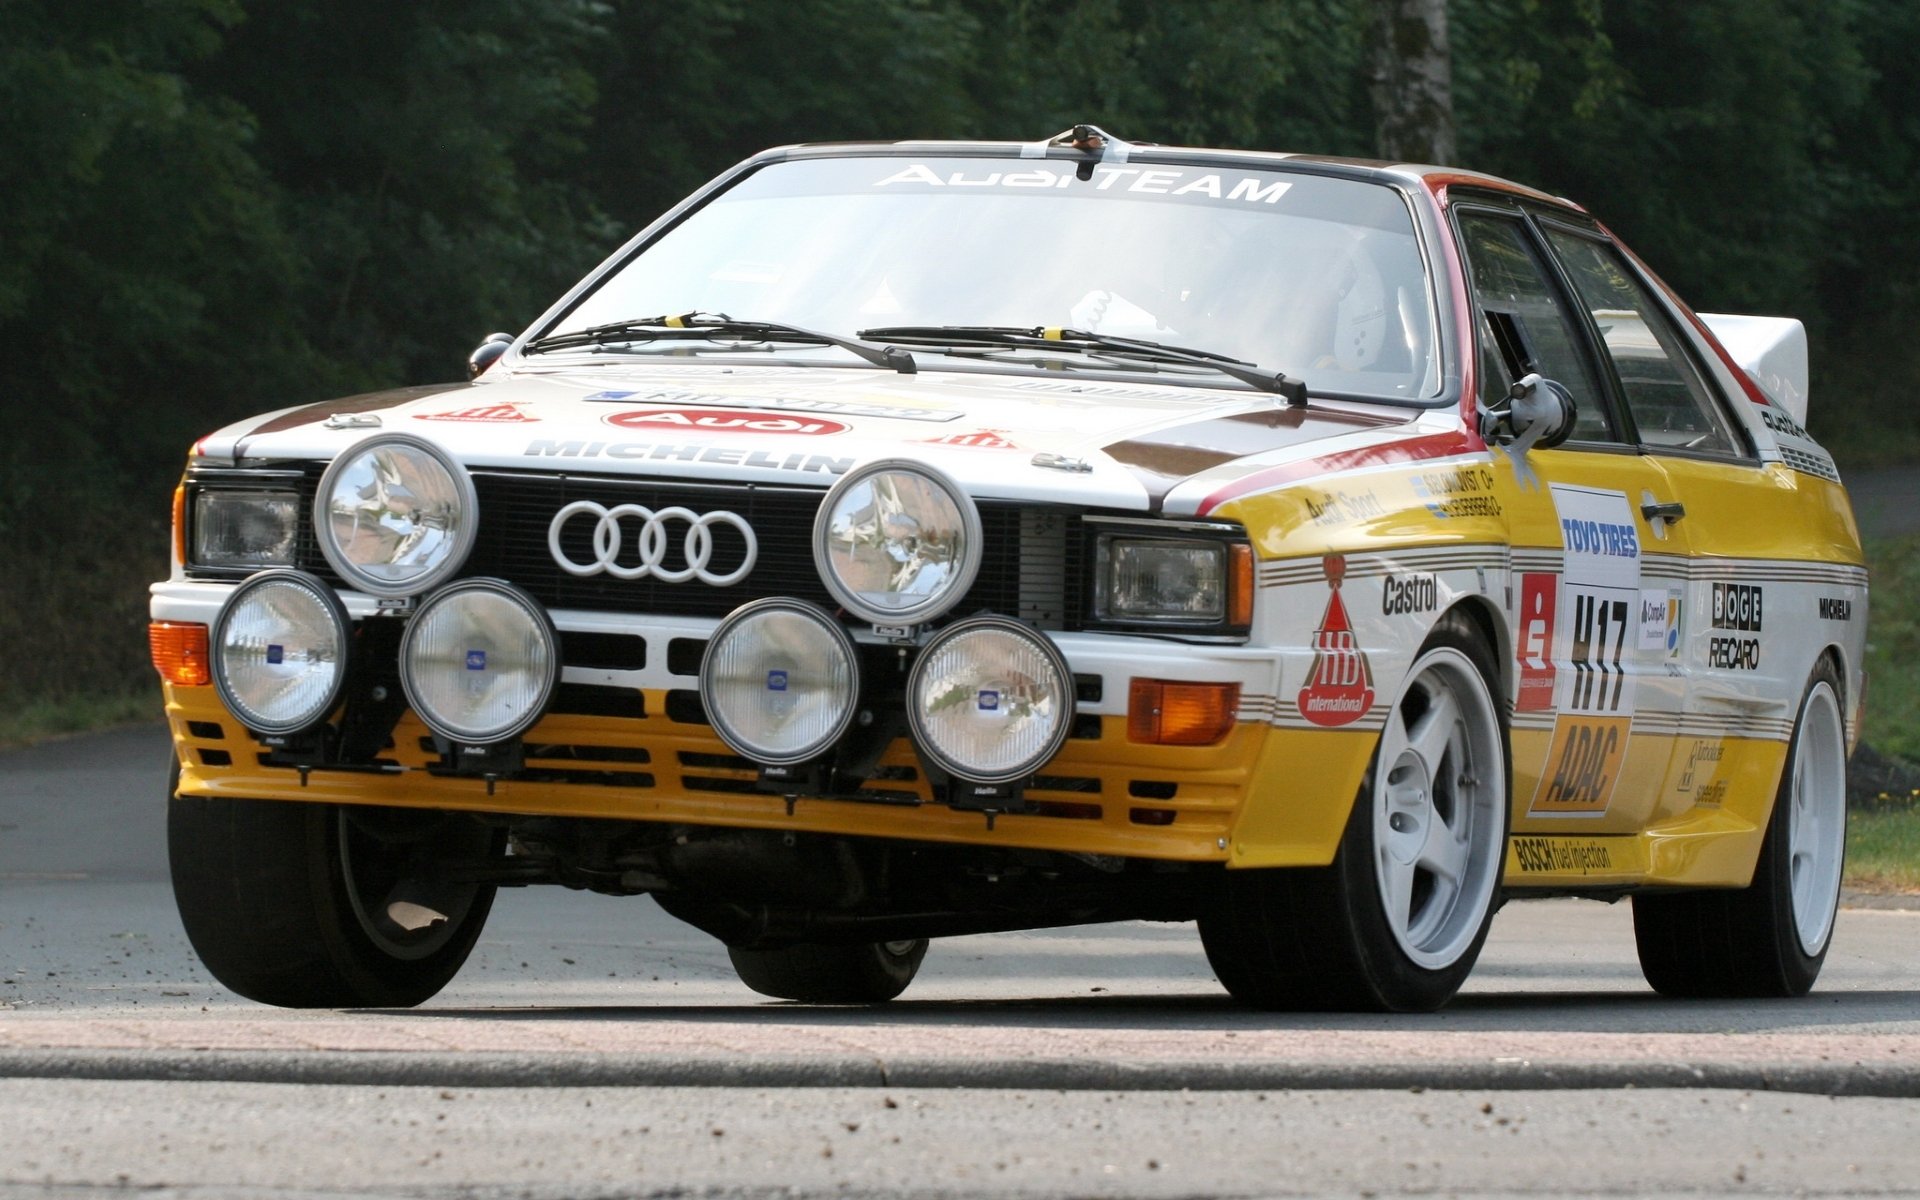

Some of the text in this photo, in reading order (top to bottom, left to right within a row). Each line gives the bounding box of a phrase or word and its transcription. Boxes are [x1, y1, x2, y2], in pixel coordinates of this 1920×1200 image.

[621, 412, 825, 433] Audi
[523, 440, 856, 475] MICHELIN
[1562, 519, 1638, 558] TOYO TIRES
[1382, 573, 1437, 615] Castrol
[1713, 588, 1761, 624] BOGE
[1647, 602, 1666, 624] CompAir
[1312, 630, 1361, 686] HB
[1572, 594, 1628, 711] H17
[1708, 637, 1760, 670] RECARO
[1306, 694, 1365, 712] international
[1546, 725, 1618, 802] ADAC
[1513, 838, 1612, 875] BOSCH fuel injection
